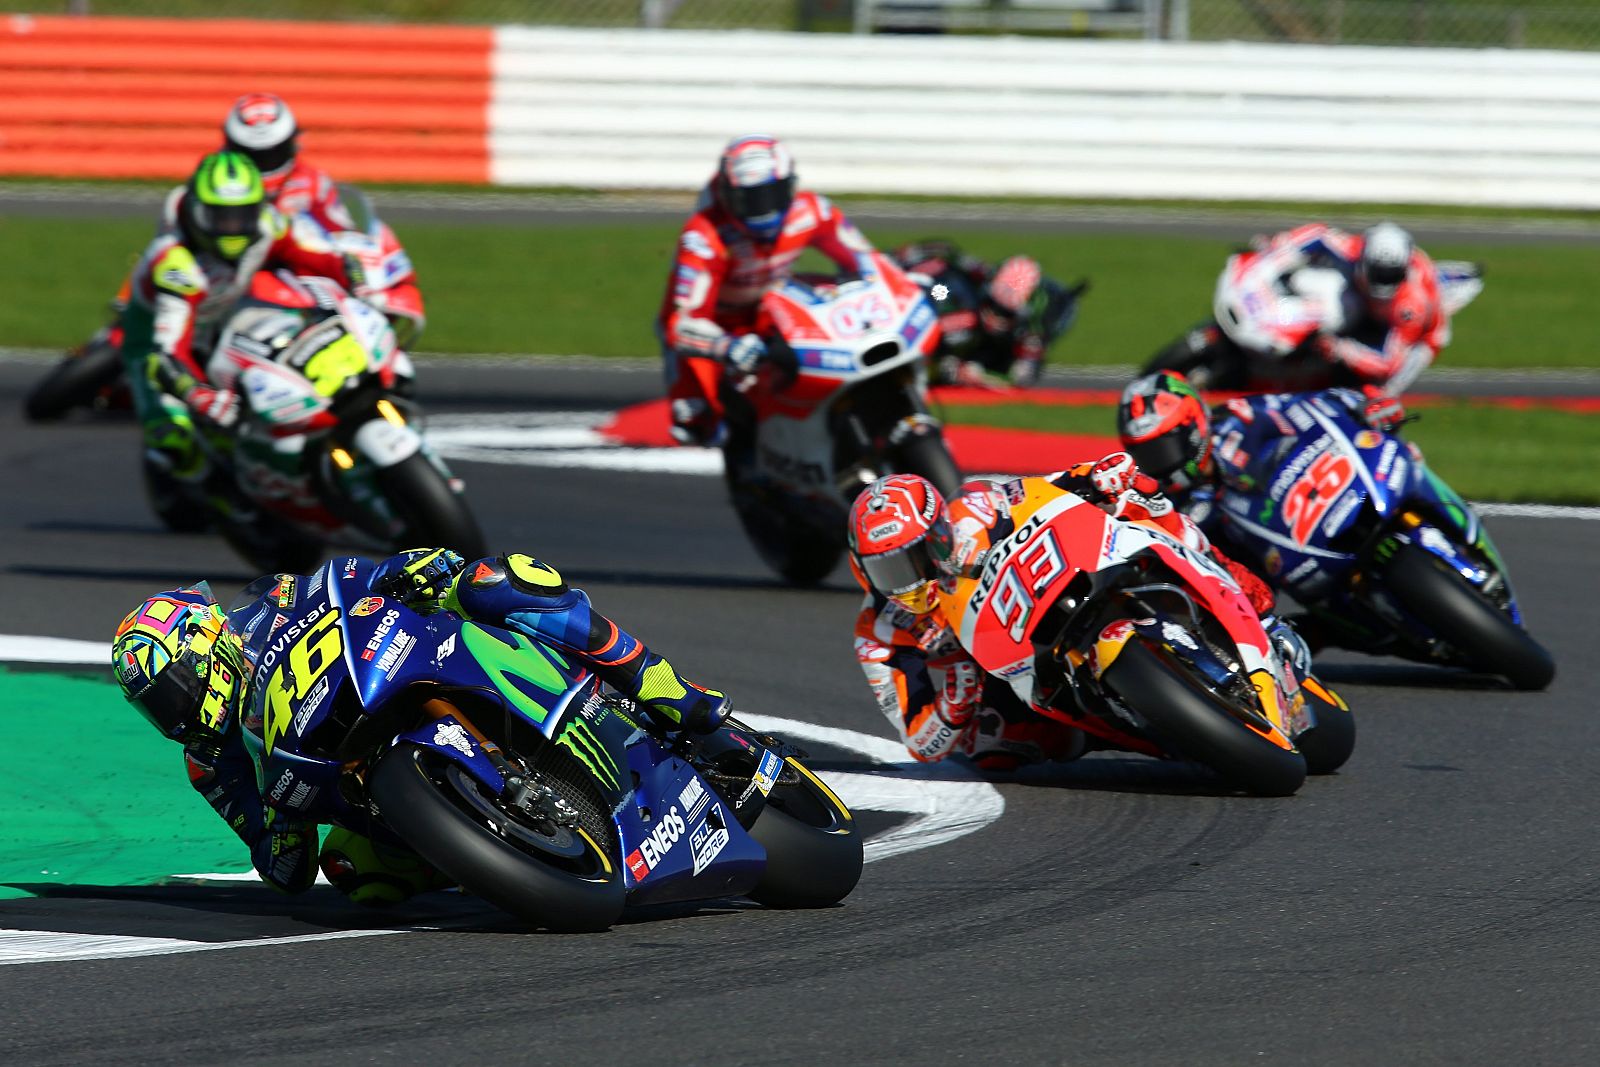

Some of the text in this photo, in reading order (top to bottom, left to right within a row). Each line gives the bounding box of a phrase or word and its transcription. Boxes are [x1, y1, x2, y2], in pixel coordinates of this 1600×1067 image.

[871, 523, 898, 538] SHOEI
[1282, 452, 1353, 547] 25
[970, 515, 1047, 613] REPSOL
[990, 526, 1068, 642] 93
[255, 601, 327, 691] movistar
[365, 608, 400, 651] ENEOS
[374, 628, 410, 673] YAMALUBE
[263, 607, 343, 757] 46
[917, 727, 953, 757] REPSO
[270, 768, 294, 801] ENEOS
[639, 805, 686, 871] ENEOS
